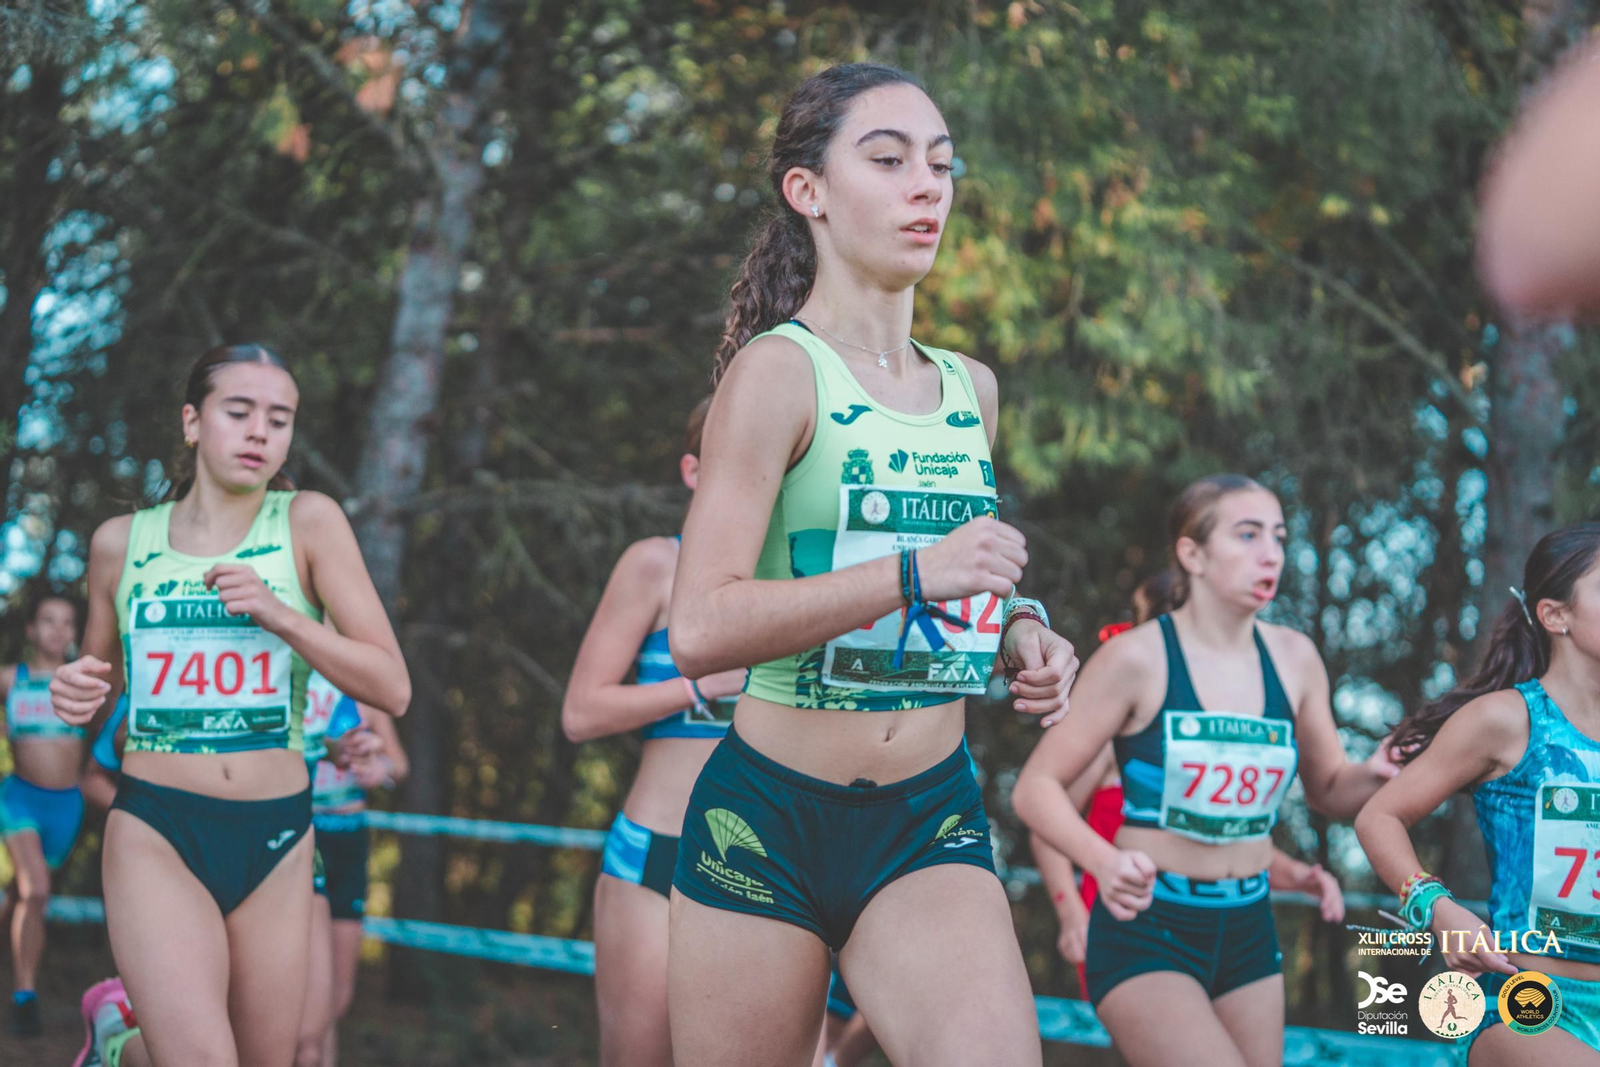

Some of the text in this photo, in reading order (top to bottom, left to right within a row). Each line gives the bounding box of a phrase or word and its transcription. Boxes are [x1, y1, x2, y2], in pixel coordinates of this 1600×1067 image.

[912, 451, 971, 463] Fundación
[914, 463, 959, 478] Unicaja
[901, 494, 974, 522] ITÁLICA
[146, 650, 278, 696] 7401
[1181, 762, 1286, 806] 7287
